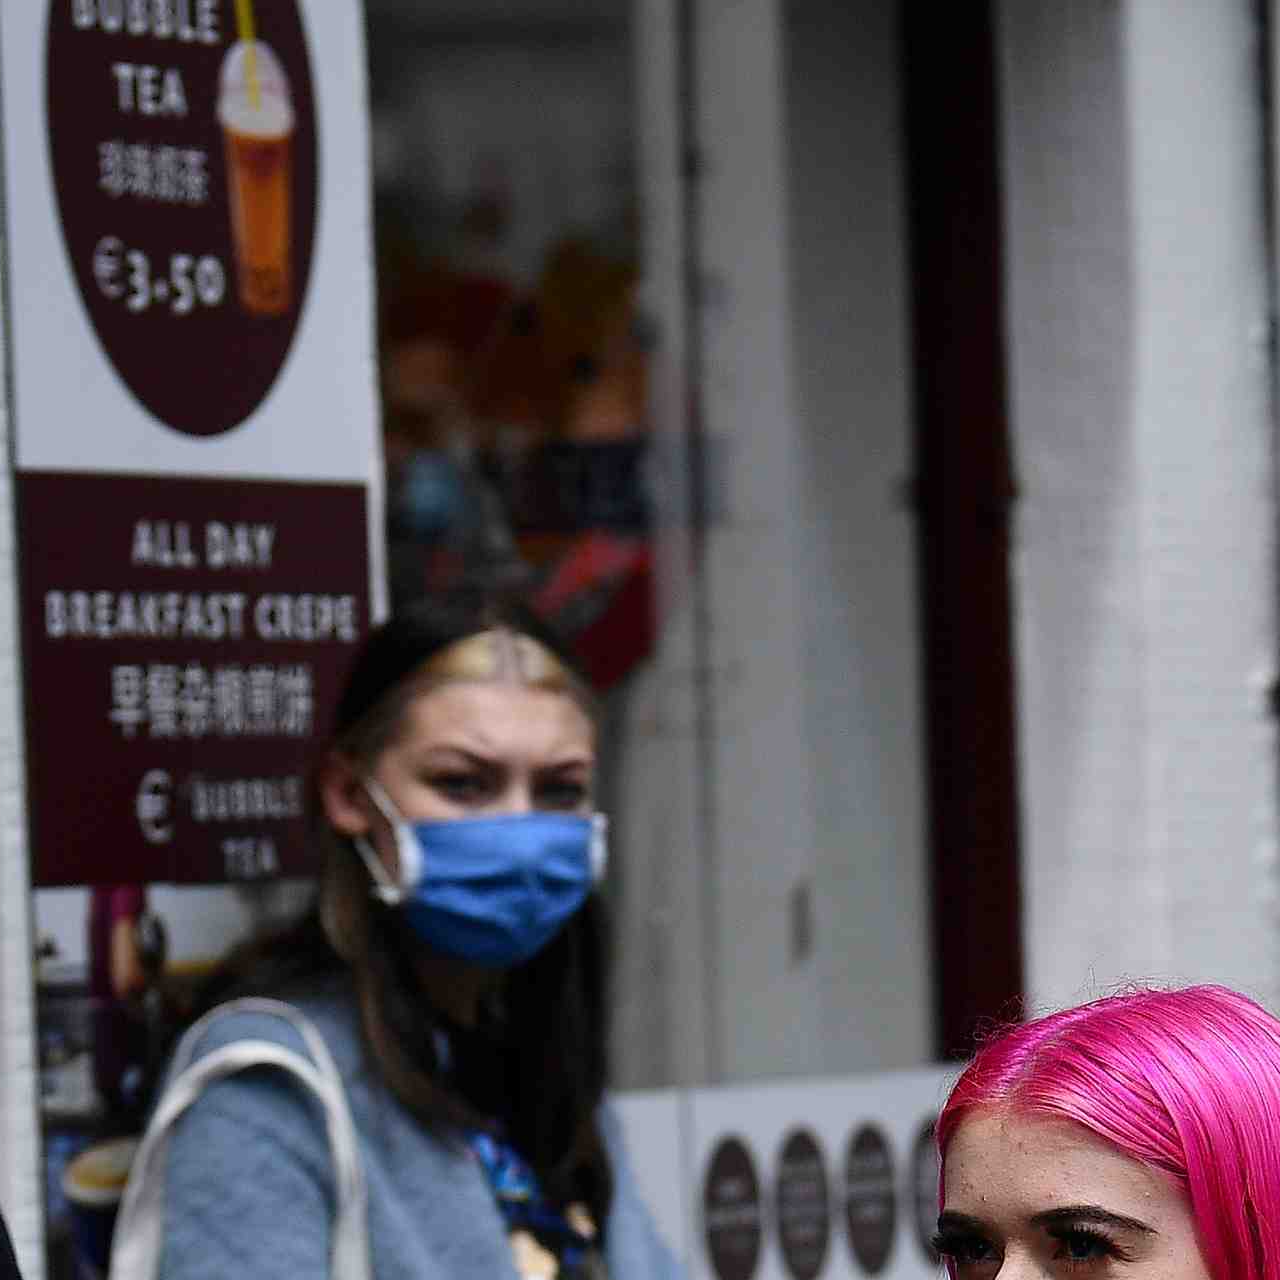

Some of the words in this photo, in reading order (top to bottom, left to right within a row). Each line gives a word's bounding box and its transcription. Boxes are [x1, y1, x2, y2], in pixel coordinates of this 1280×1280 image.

[112, 62, 188, 116] TEA
[131, 521, 197, 568] ALL
[205, 522, 275, 568] DAY
[44, 590, 246, 640] BREAKFAST
[254, 593, 358, 642] CREPE
